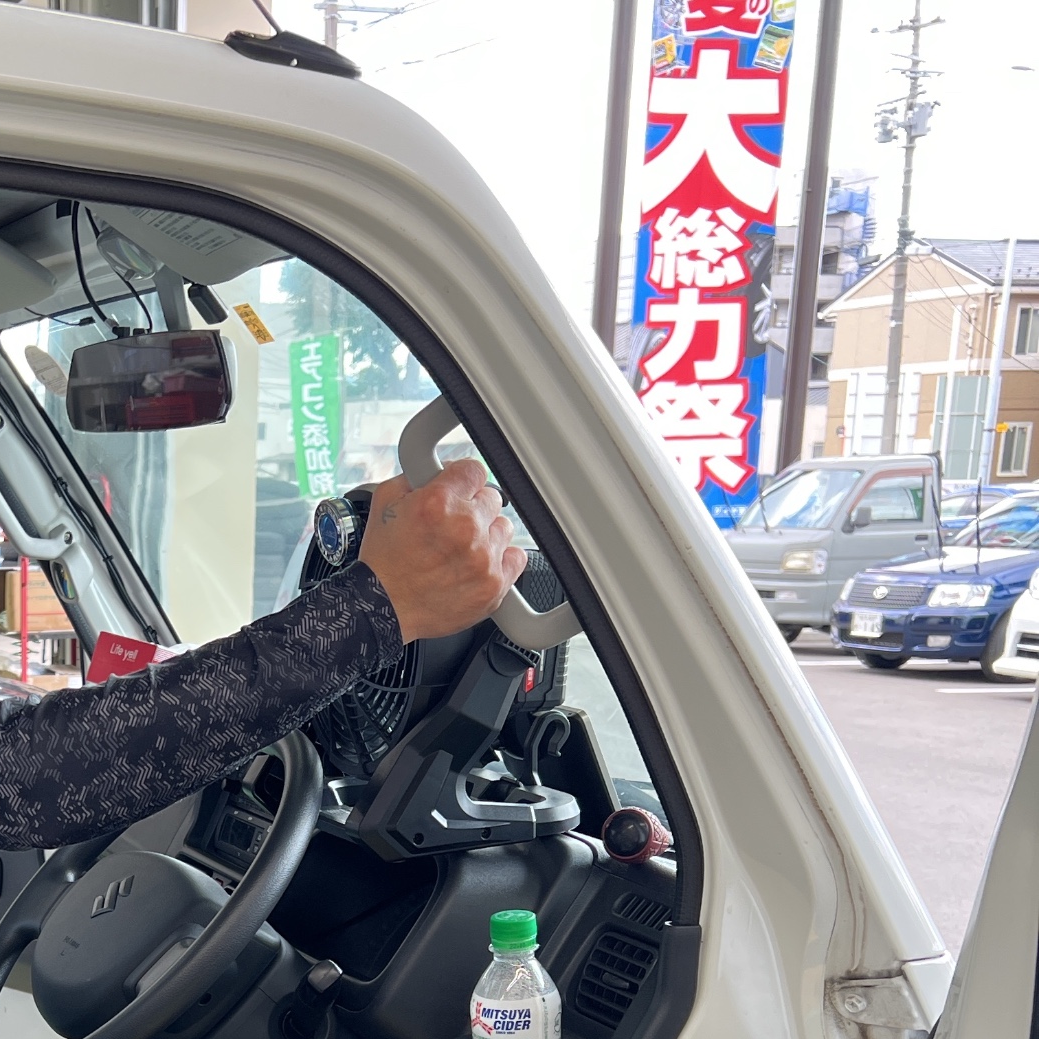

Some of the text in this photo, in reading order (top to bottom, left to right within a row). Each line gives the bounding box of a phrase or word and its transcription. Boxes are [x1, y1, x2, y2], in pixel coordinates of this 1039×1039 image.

[641, 49, 780, 489] 大総力祭
[481, 1007, 531, 1020] MITSUYA
[493, 1018, 531, 1031] CIDER
